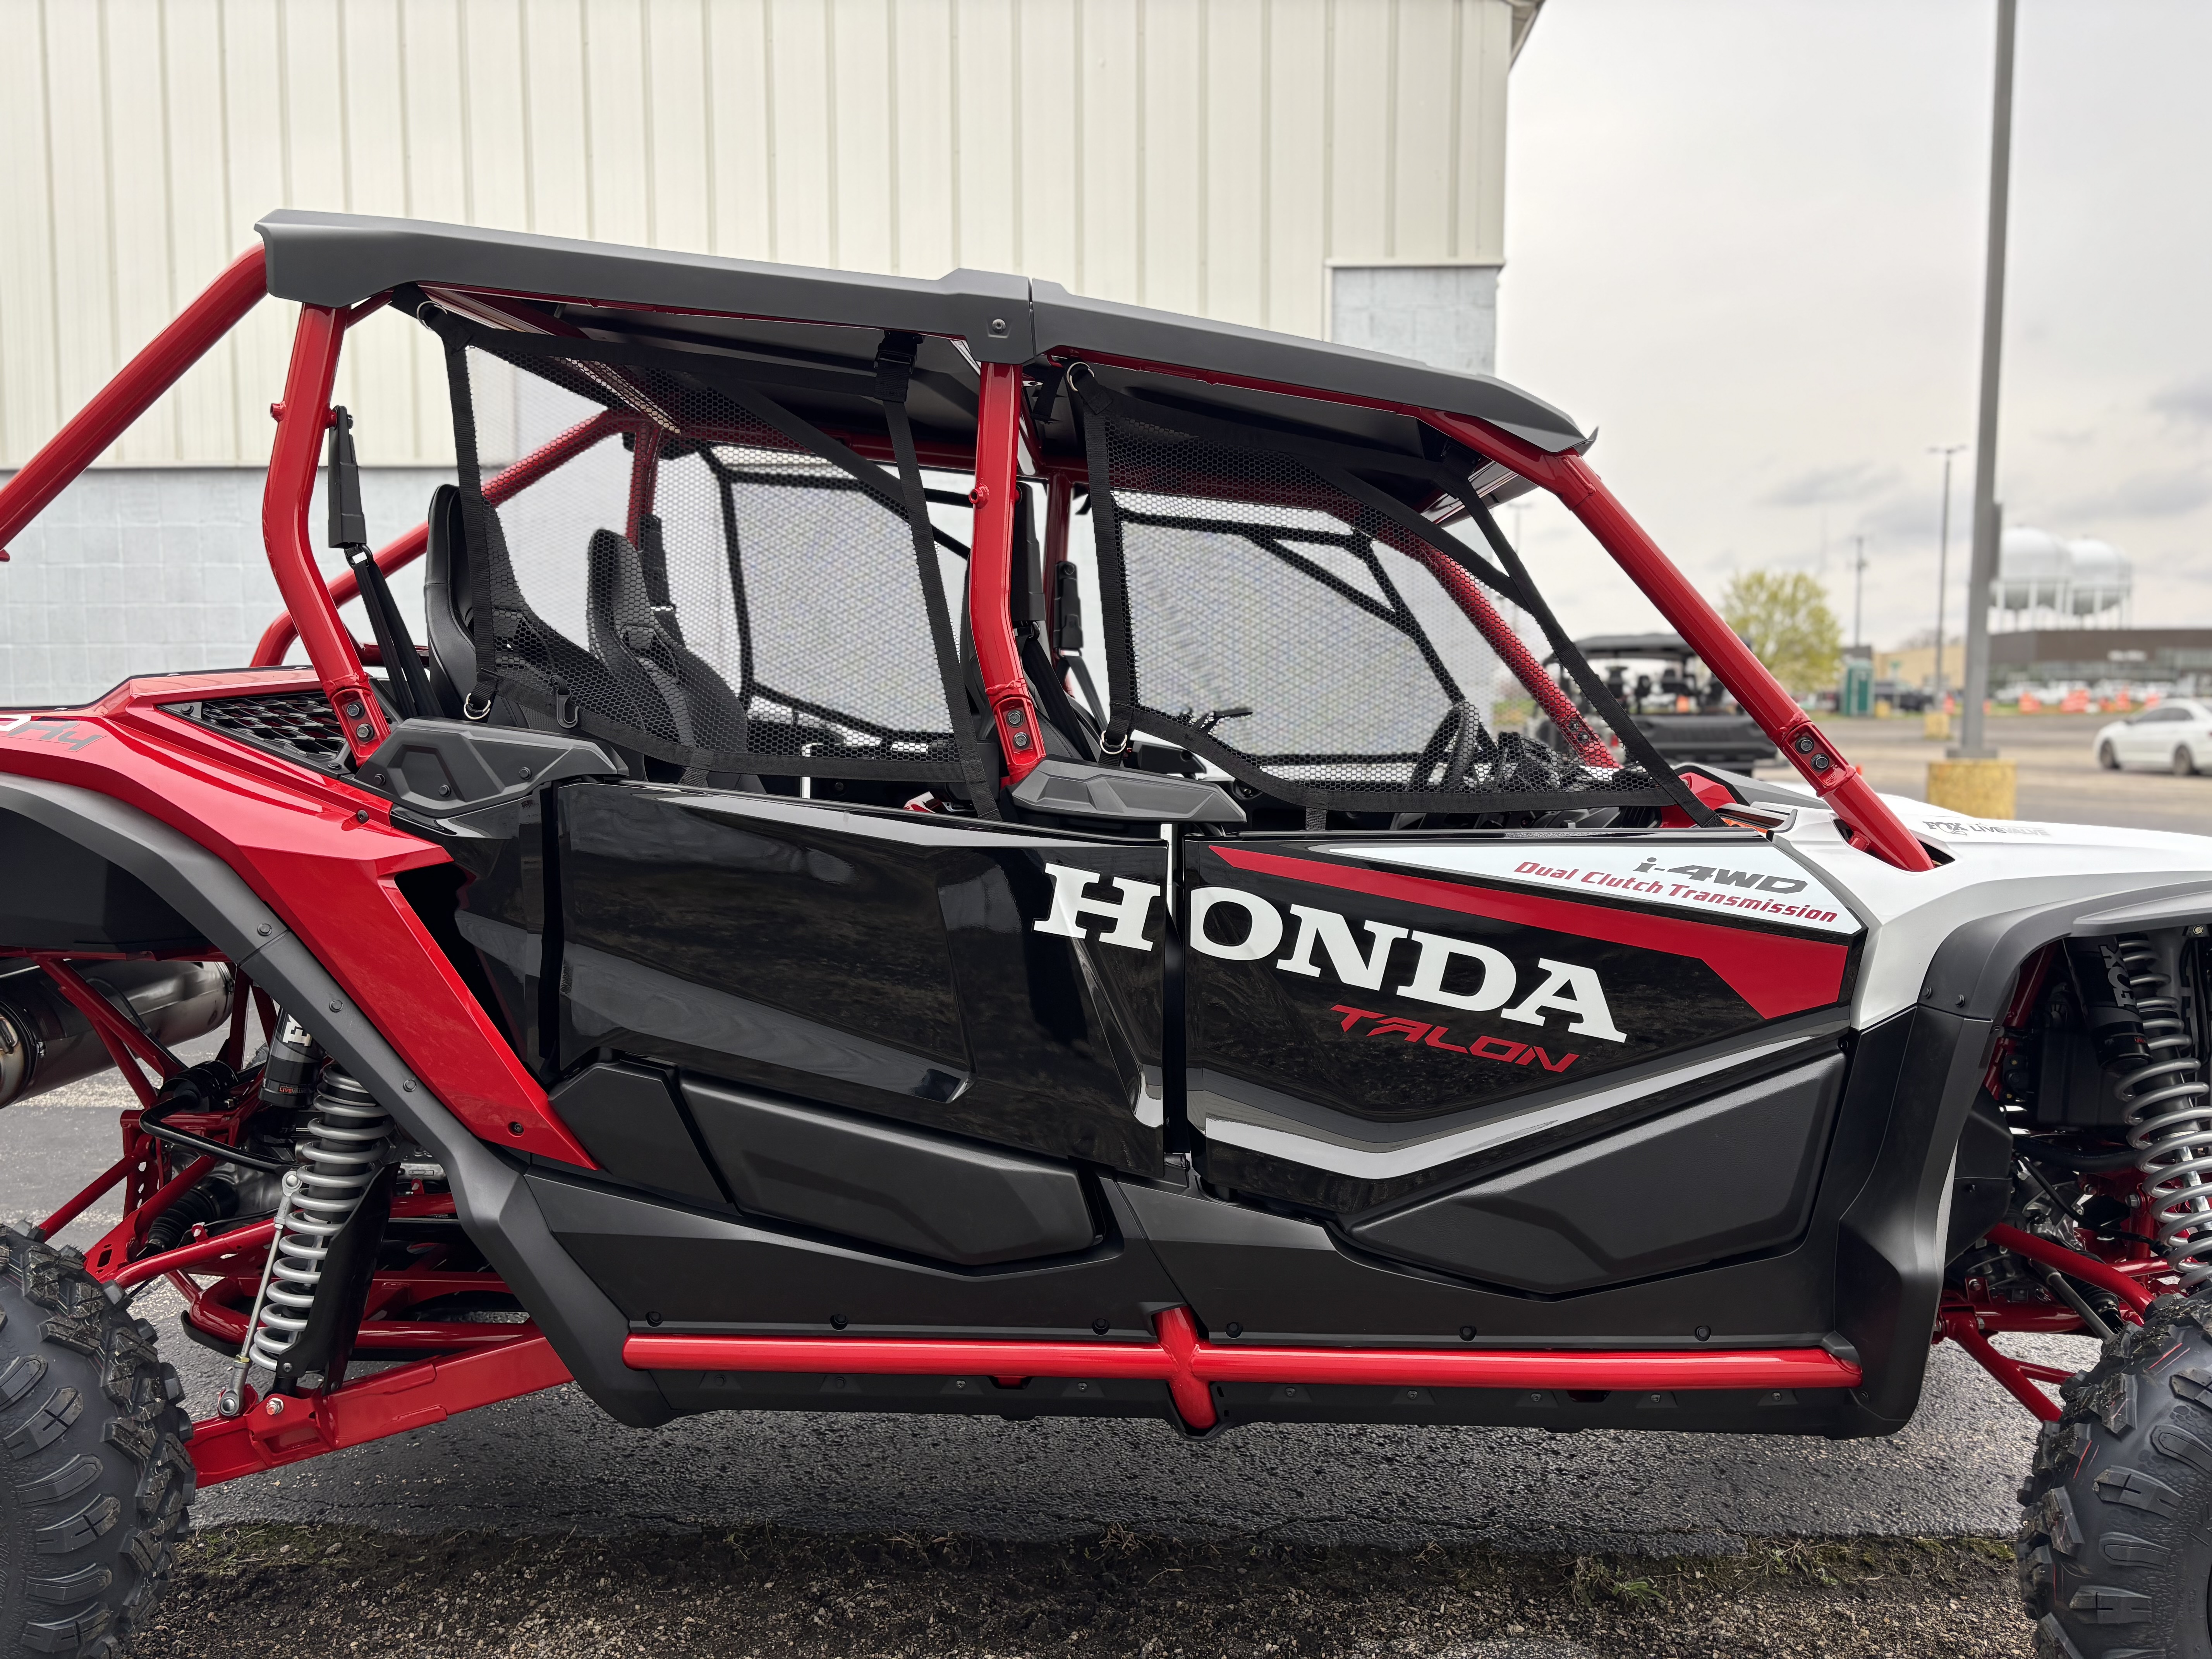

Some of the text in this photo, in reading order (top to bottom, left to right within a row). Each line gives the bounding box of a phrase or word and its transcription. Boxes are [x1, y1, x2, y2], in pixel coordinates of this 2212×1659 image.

[1922, 821, 1969, 836] FOX
[1514, 861, 1838, 922] Dual Clutch Transmission
[1632, 857, 1808, 894] i-4WD
[1033, 862, 1628, 1044] HONDA
[2100, 946, 2137, 1008] FOX
[1331, 1004, 1580, 1073] TALON
